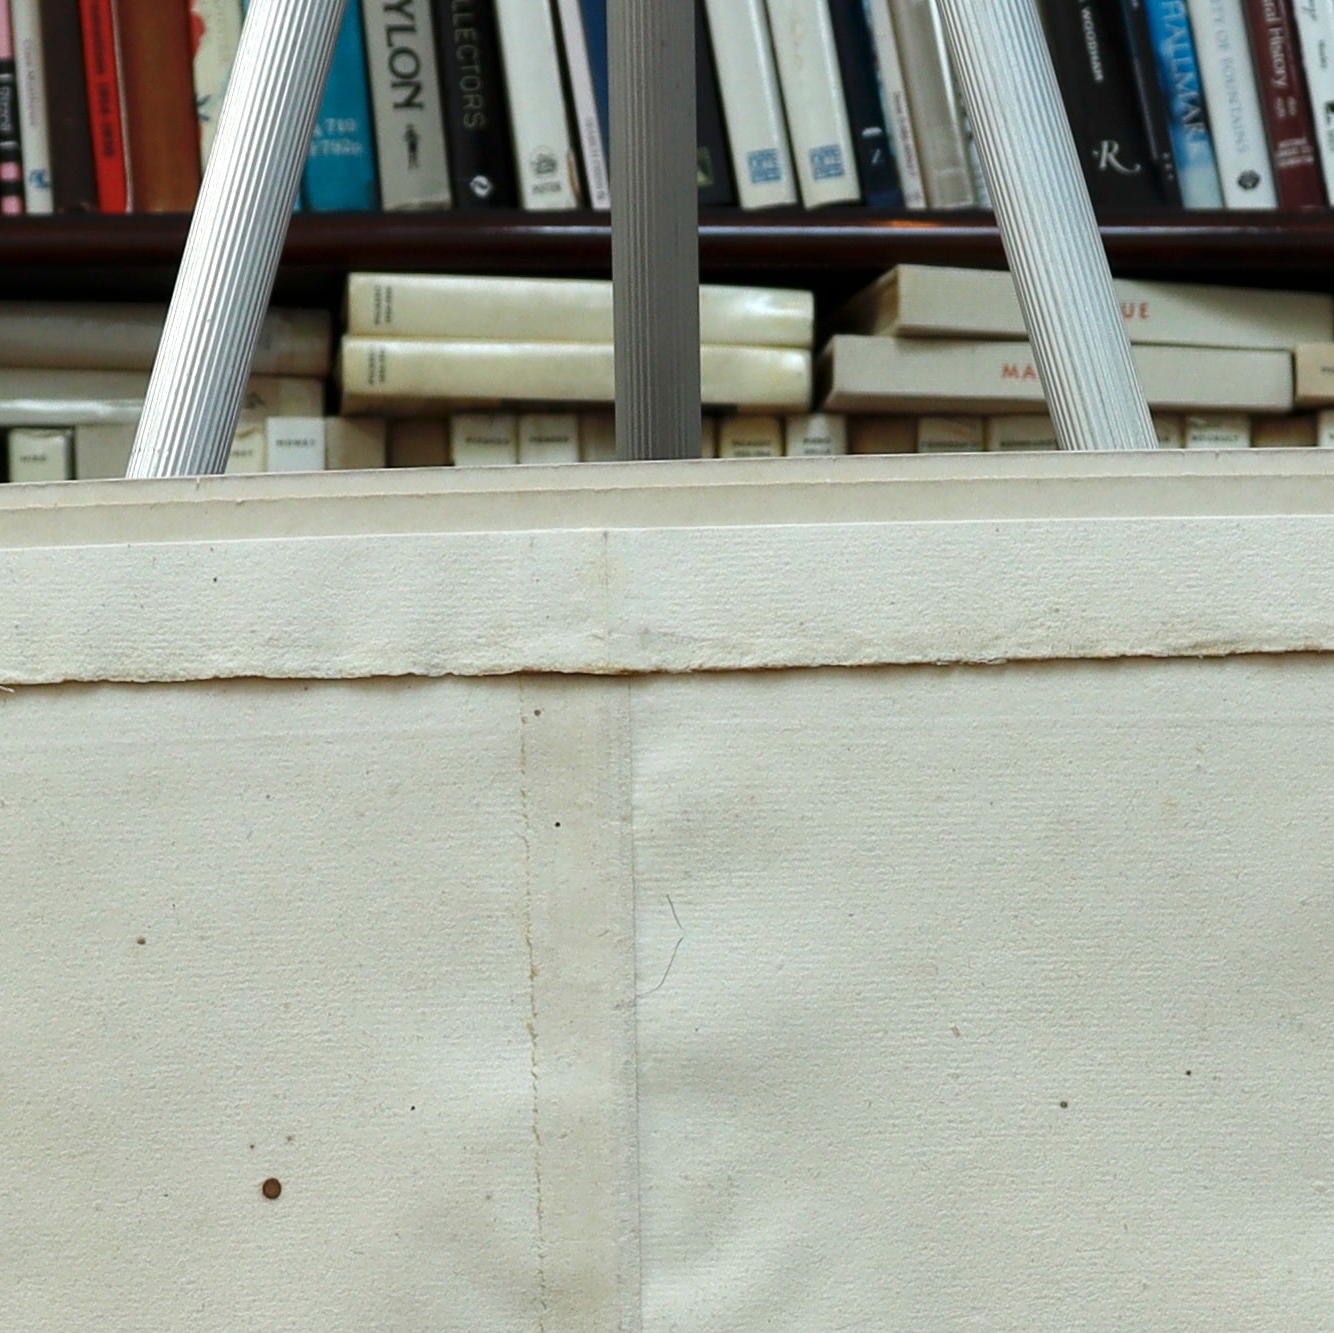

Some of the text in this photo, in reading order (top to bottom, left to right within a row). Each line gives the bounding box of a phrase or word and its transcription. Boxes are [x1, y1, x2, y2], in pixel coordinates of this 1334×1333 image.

[1269, 27, 1290, 88] History
[1121, 302, 1150, 320] UE
[1001, 363, 1038, 381] MA
